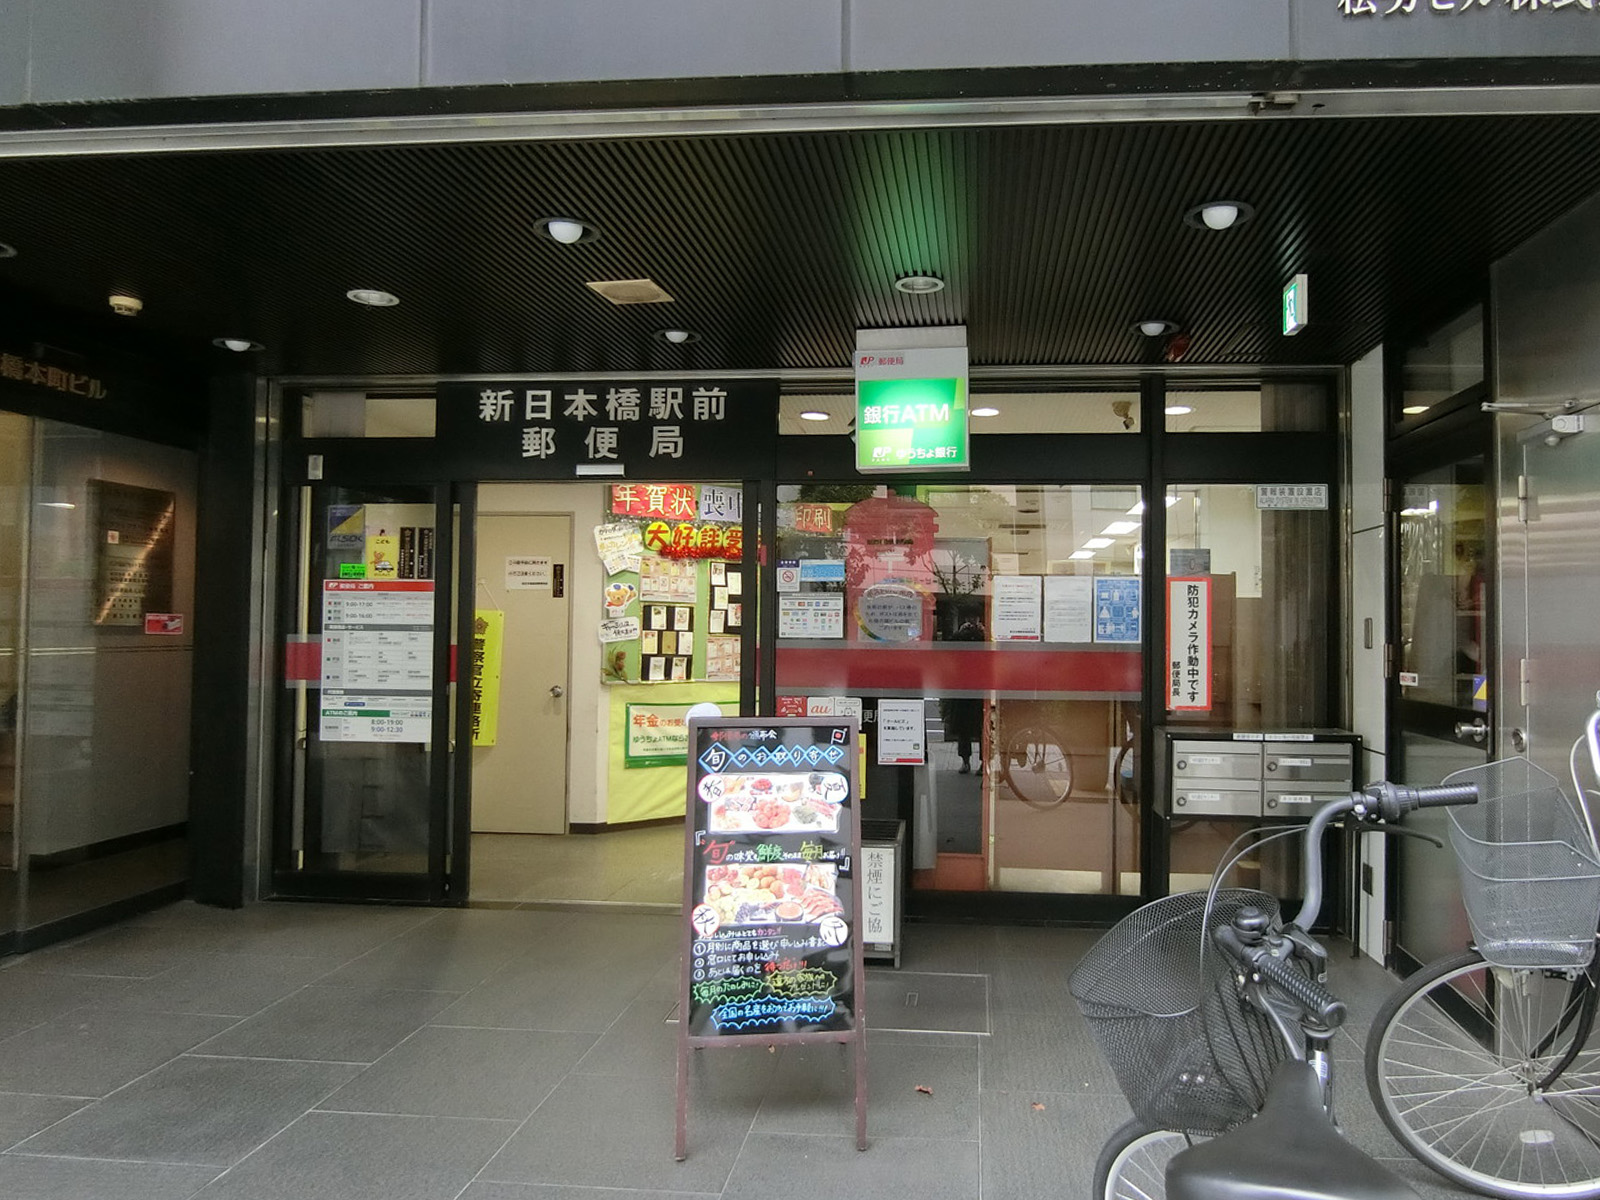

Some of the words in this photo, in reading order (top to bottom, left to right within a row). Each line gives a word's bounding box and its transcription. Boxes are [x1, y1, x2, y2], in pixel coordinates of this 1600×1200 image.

[878, 357, 904, 365] 郵便局
[479, 387, 728, 422] 新日本橋駅前
[864, 403, 950, 424] 銀行ATM
[522, 426, 684, 459] 郵便局
[896, 446, 957, 459] ゆうちょ銀行
[615, 484, 694, 516] 年賀状
[796, 506, 833, 531] 印刷
[1187, 584, 1200, 702] 防犯カメラ作動中です
[1172, 661, 1181, 697] 郵便局長
[811, 704, 832, 714] au
[867, 851, 883, 934] 禁煙にご協
